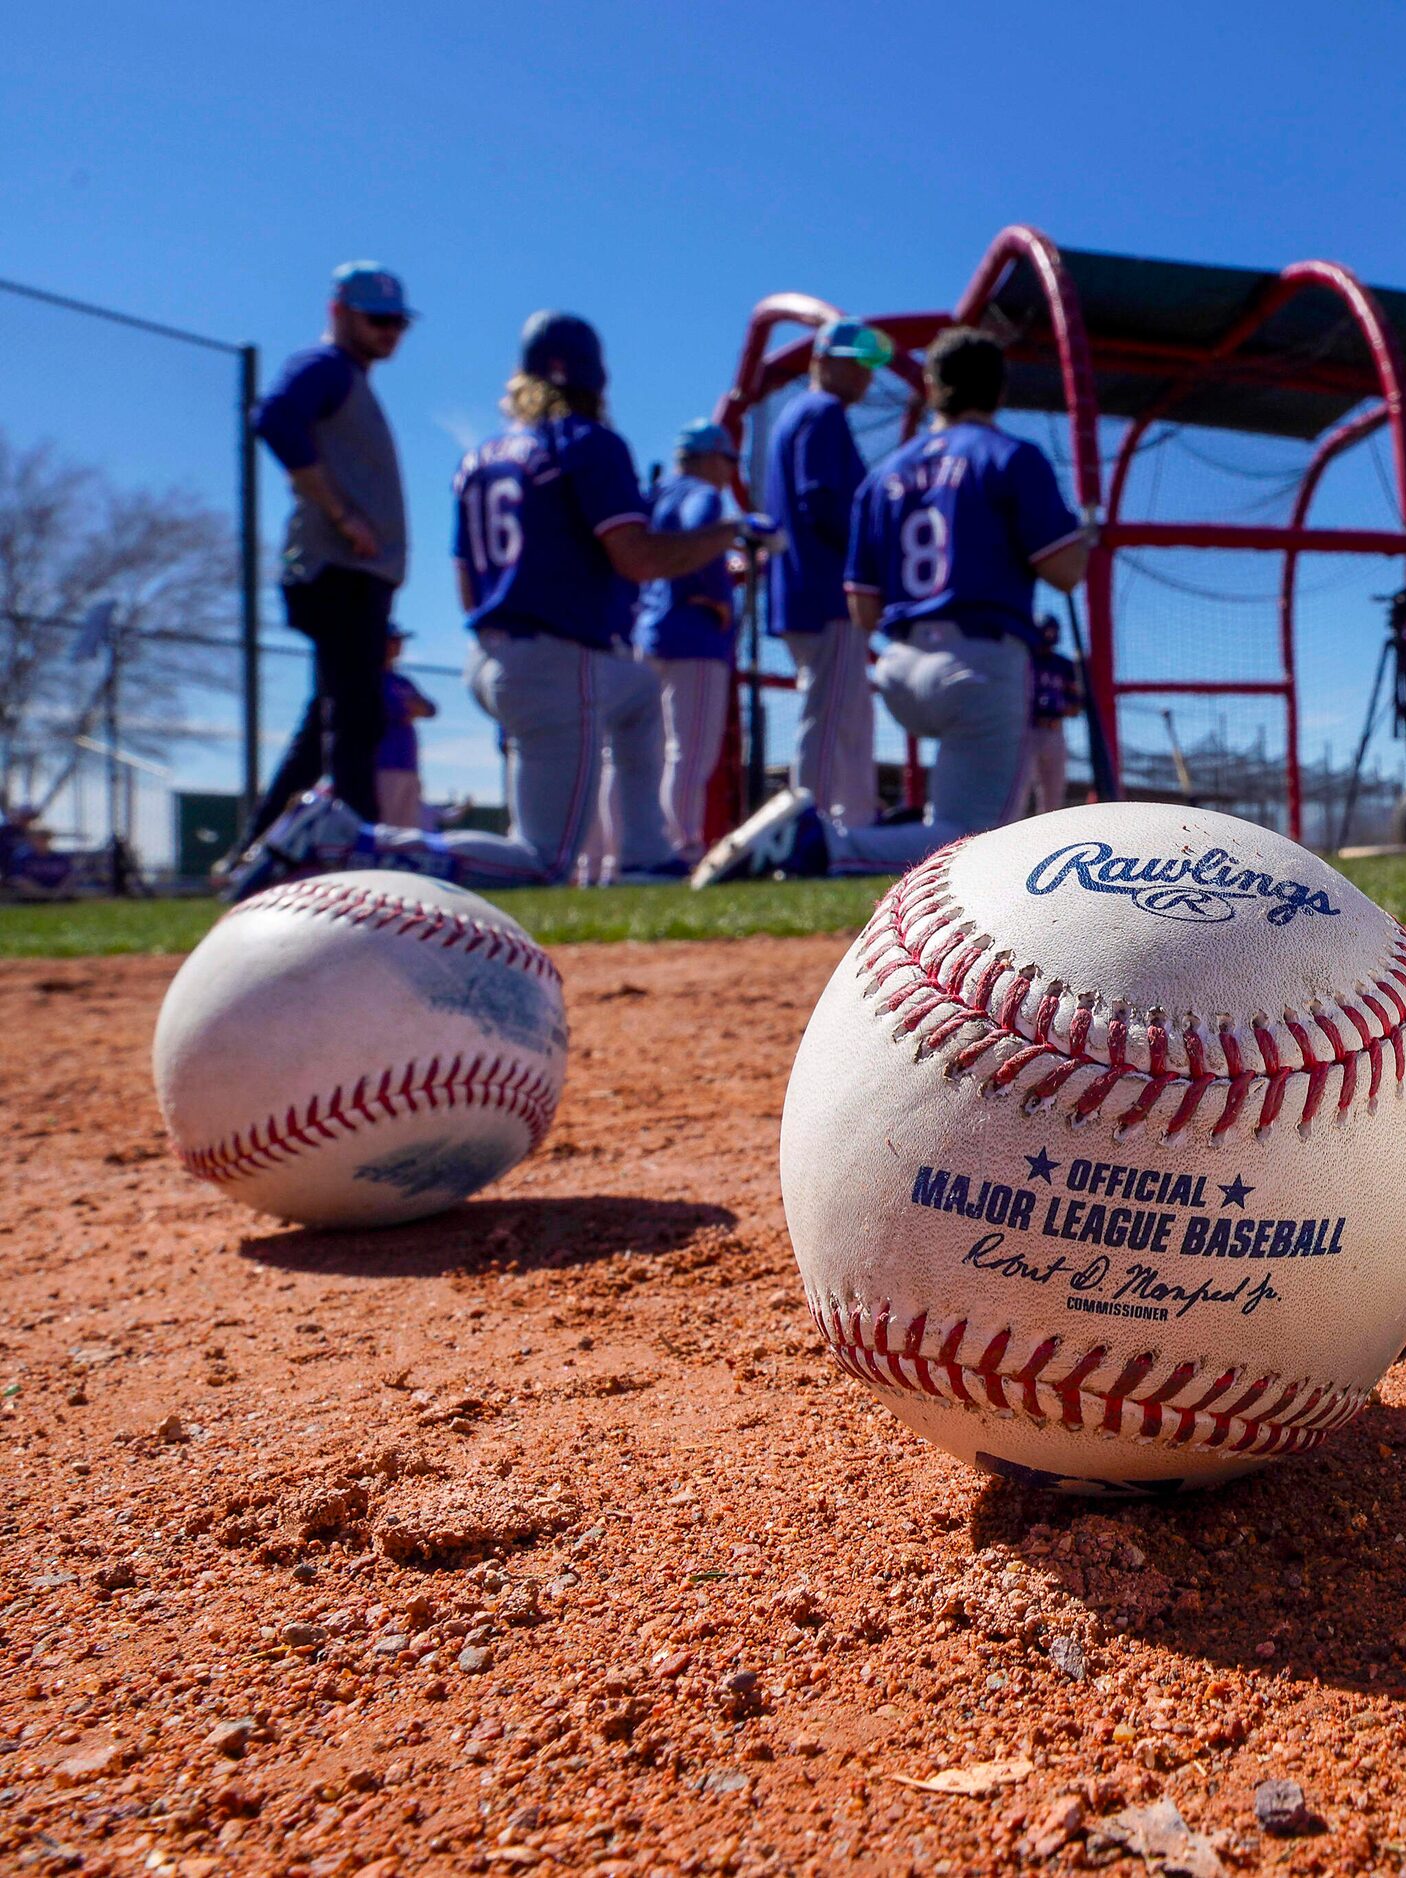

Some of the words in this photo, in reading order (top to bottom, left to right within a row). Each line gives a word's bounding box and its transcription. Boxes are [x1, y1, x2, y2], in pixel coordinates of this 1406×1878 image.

[463, 476, 523, 573] 16
[901, 506, 947, 600] 8
[1026, 842, 1341, 926] Rawlings
[911, 1165, 1037, 1231] MAJOR
[1043, 1198, 1171, 1253] LEAGUE
[1179, 1215, 1348, 1259] BASEBALL
[1066, 1158, 1207, 1208] OFFICIAL
[1066, 1297, 1170, 1322] COMMISSIONER
